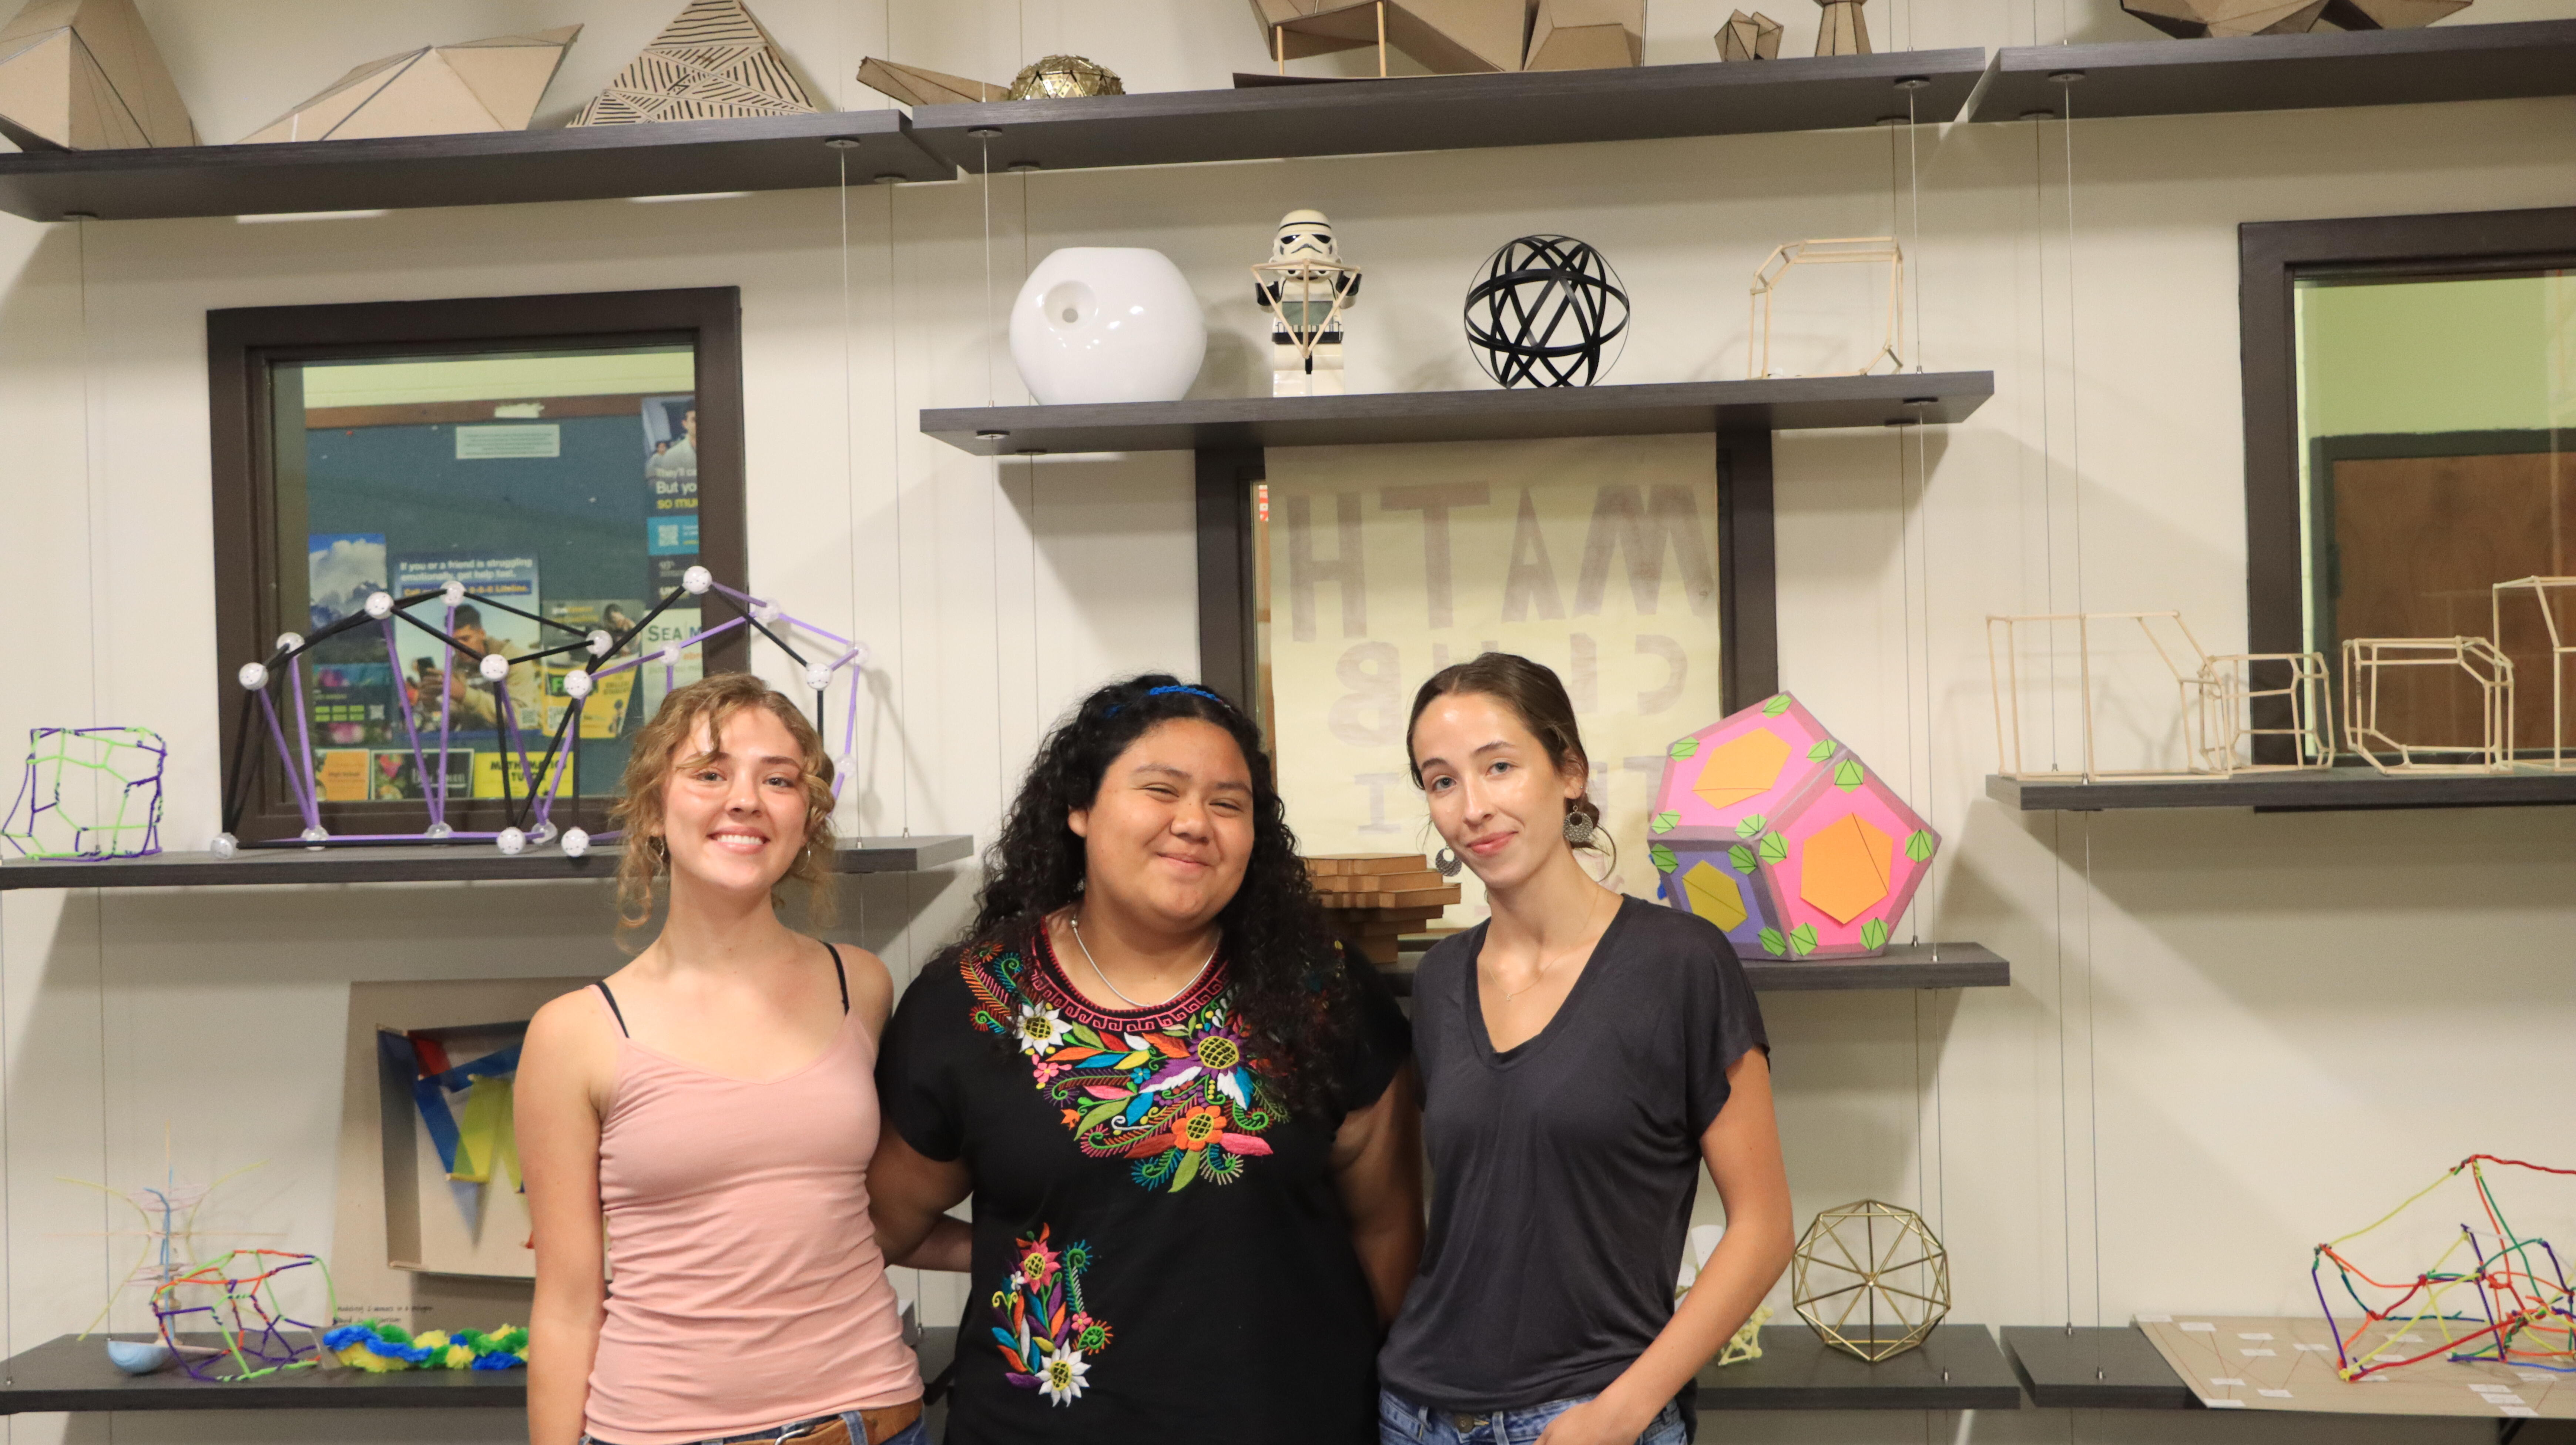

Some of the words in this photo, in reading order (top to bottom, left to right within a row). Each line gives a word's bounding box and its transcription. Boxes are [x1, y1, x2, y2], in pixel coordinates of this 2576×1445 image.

[656, 481, 678, 494] But
[682, 483, 697, 495] yo
[657, 499, 673, 509] so
[400, 562, 407, 570] If
[409, 563, 426, 572] you
[448, 560, 475, 569] friend
[486, 558, 533, 569] struggling
[456, 571, 473, 581] get
[474, 570, 494, 580] help
[648, 625, 682, 641] SEA
